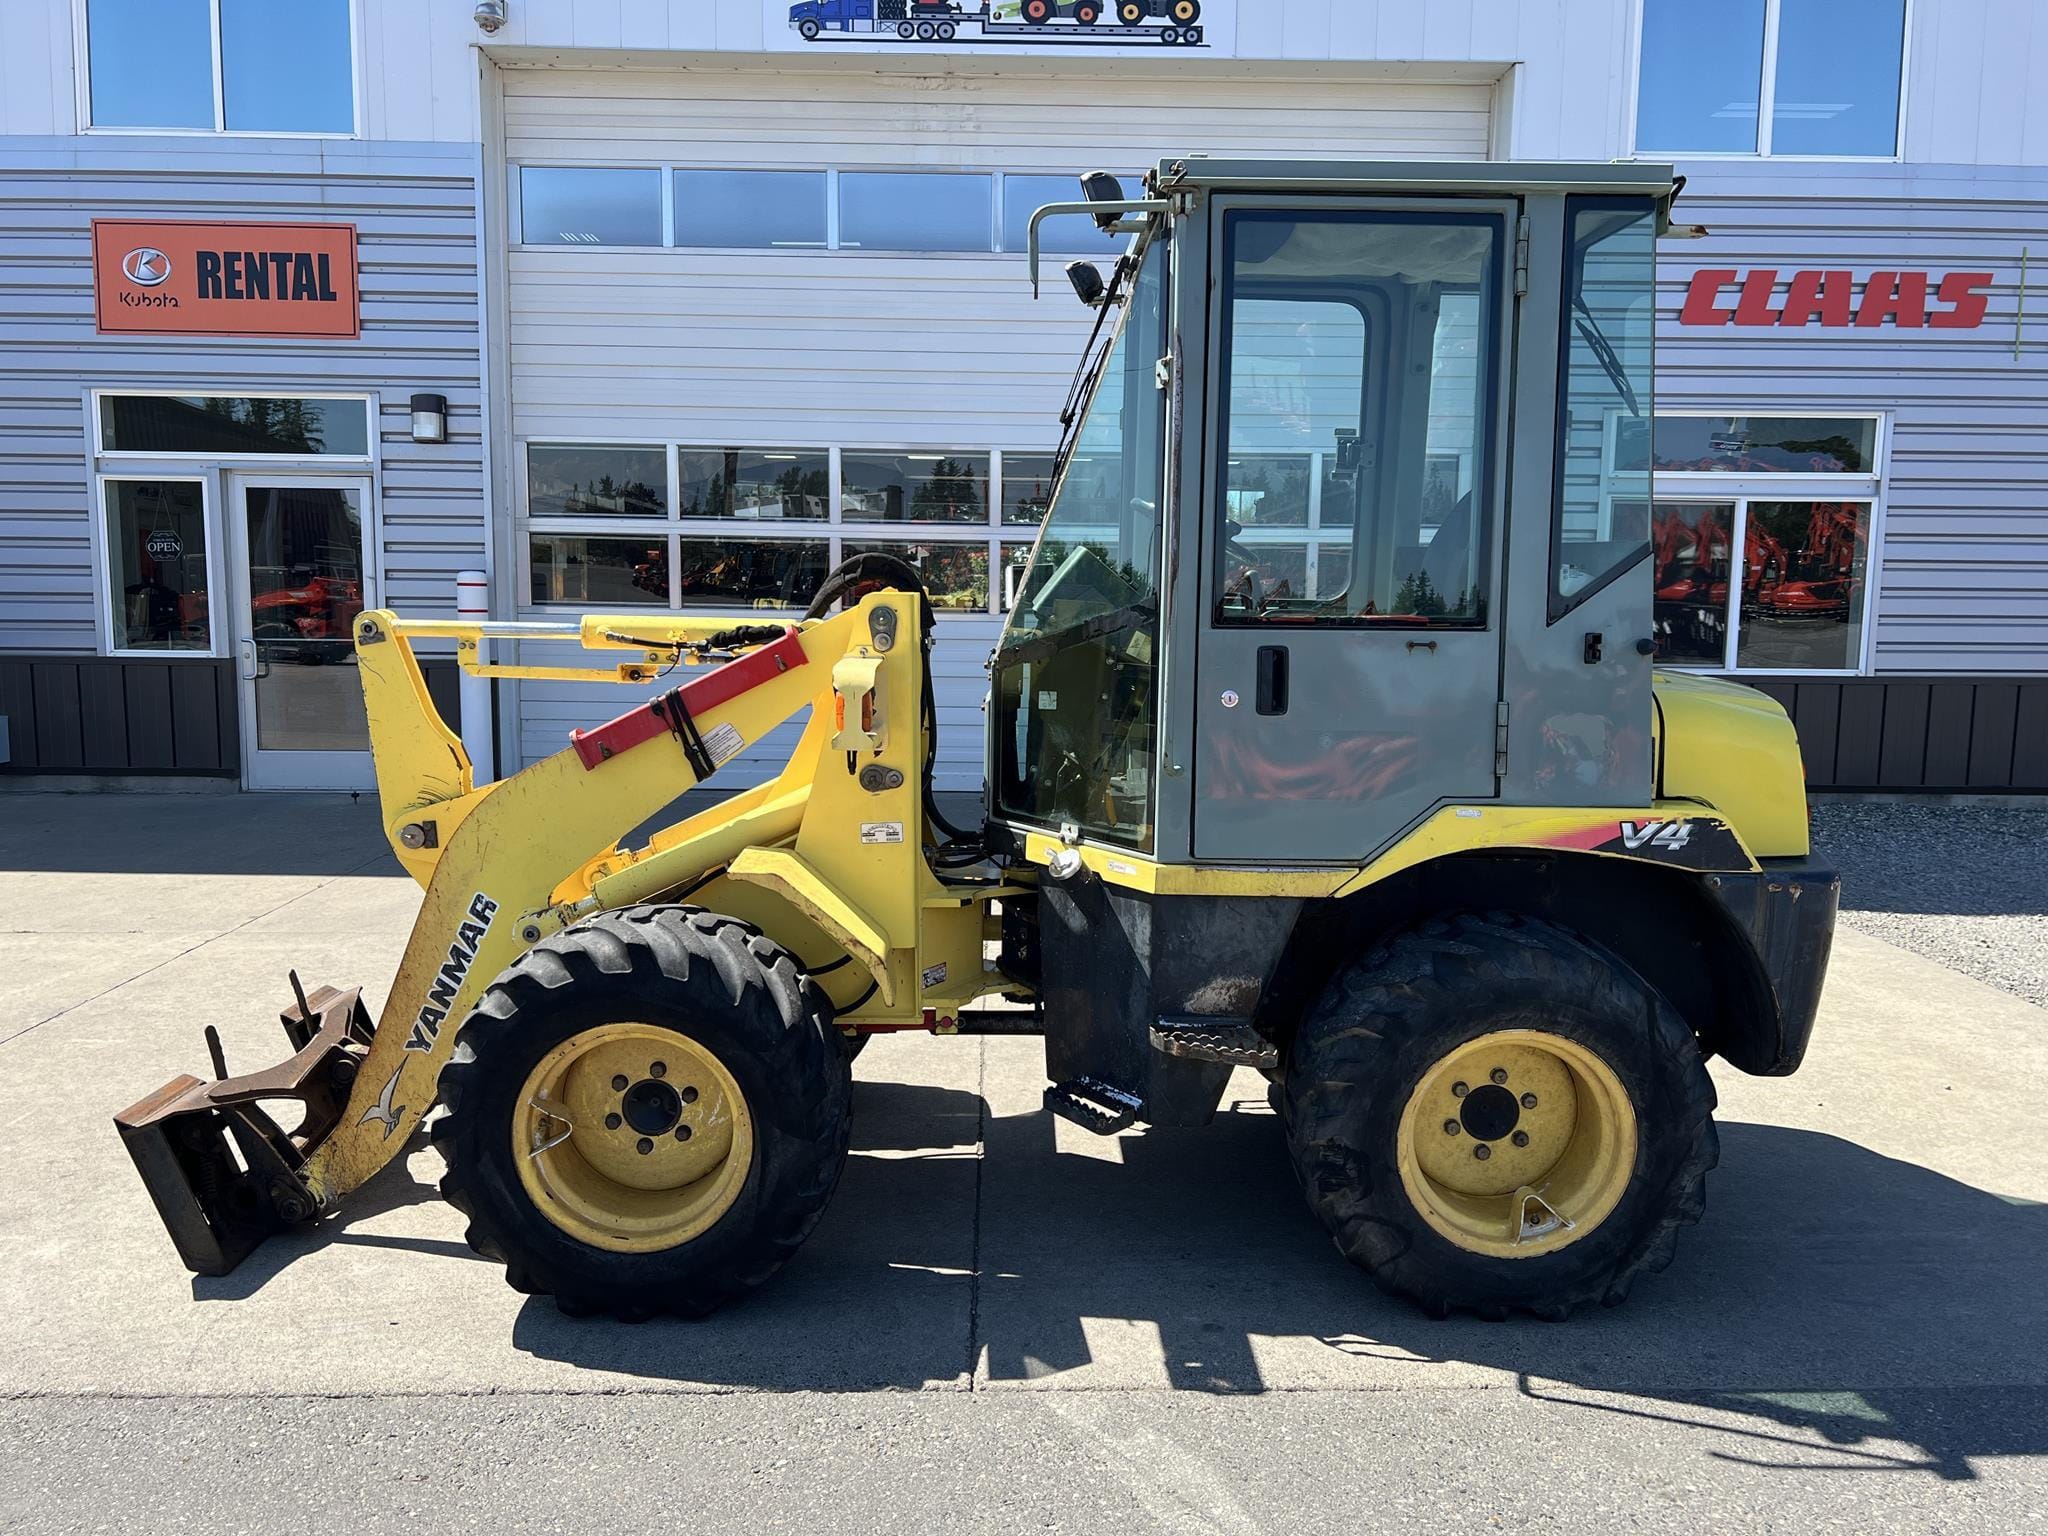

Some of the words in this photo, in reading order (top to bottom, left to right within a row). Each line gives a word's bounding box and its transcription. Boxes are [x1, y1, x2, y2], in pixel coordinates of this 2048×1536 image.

[196, 251, 337, 301] RENTAL
[119, 292, 179, 308] Kubota
[1680, 269, 1994, 328] CLAAS
[147, 542, 180, 552] OPEN
[1620, 821, 1694, 851] V4
[404, 892, 498, 1053] YANMAR
